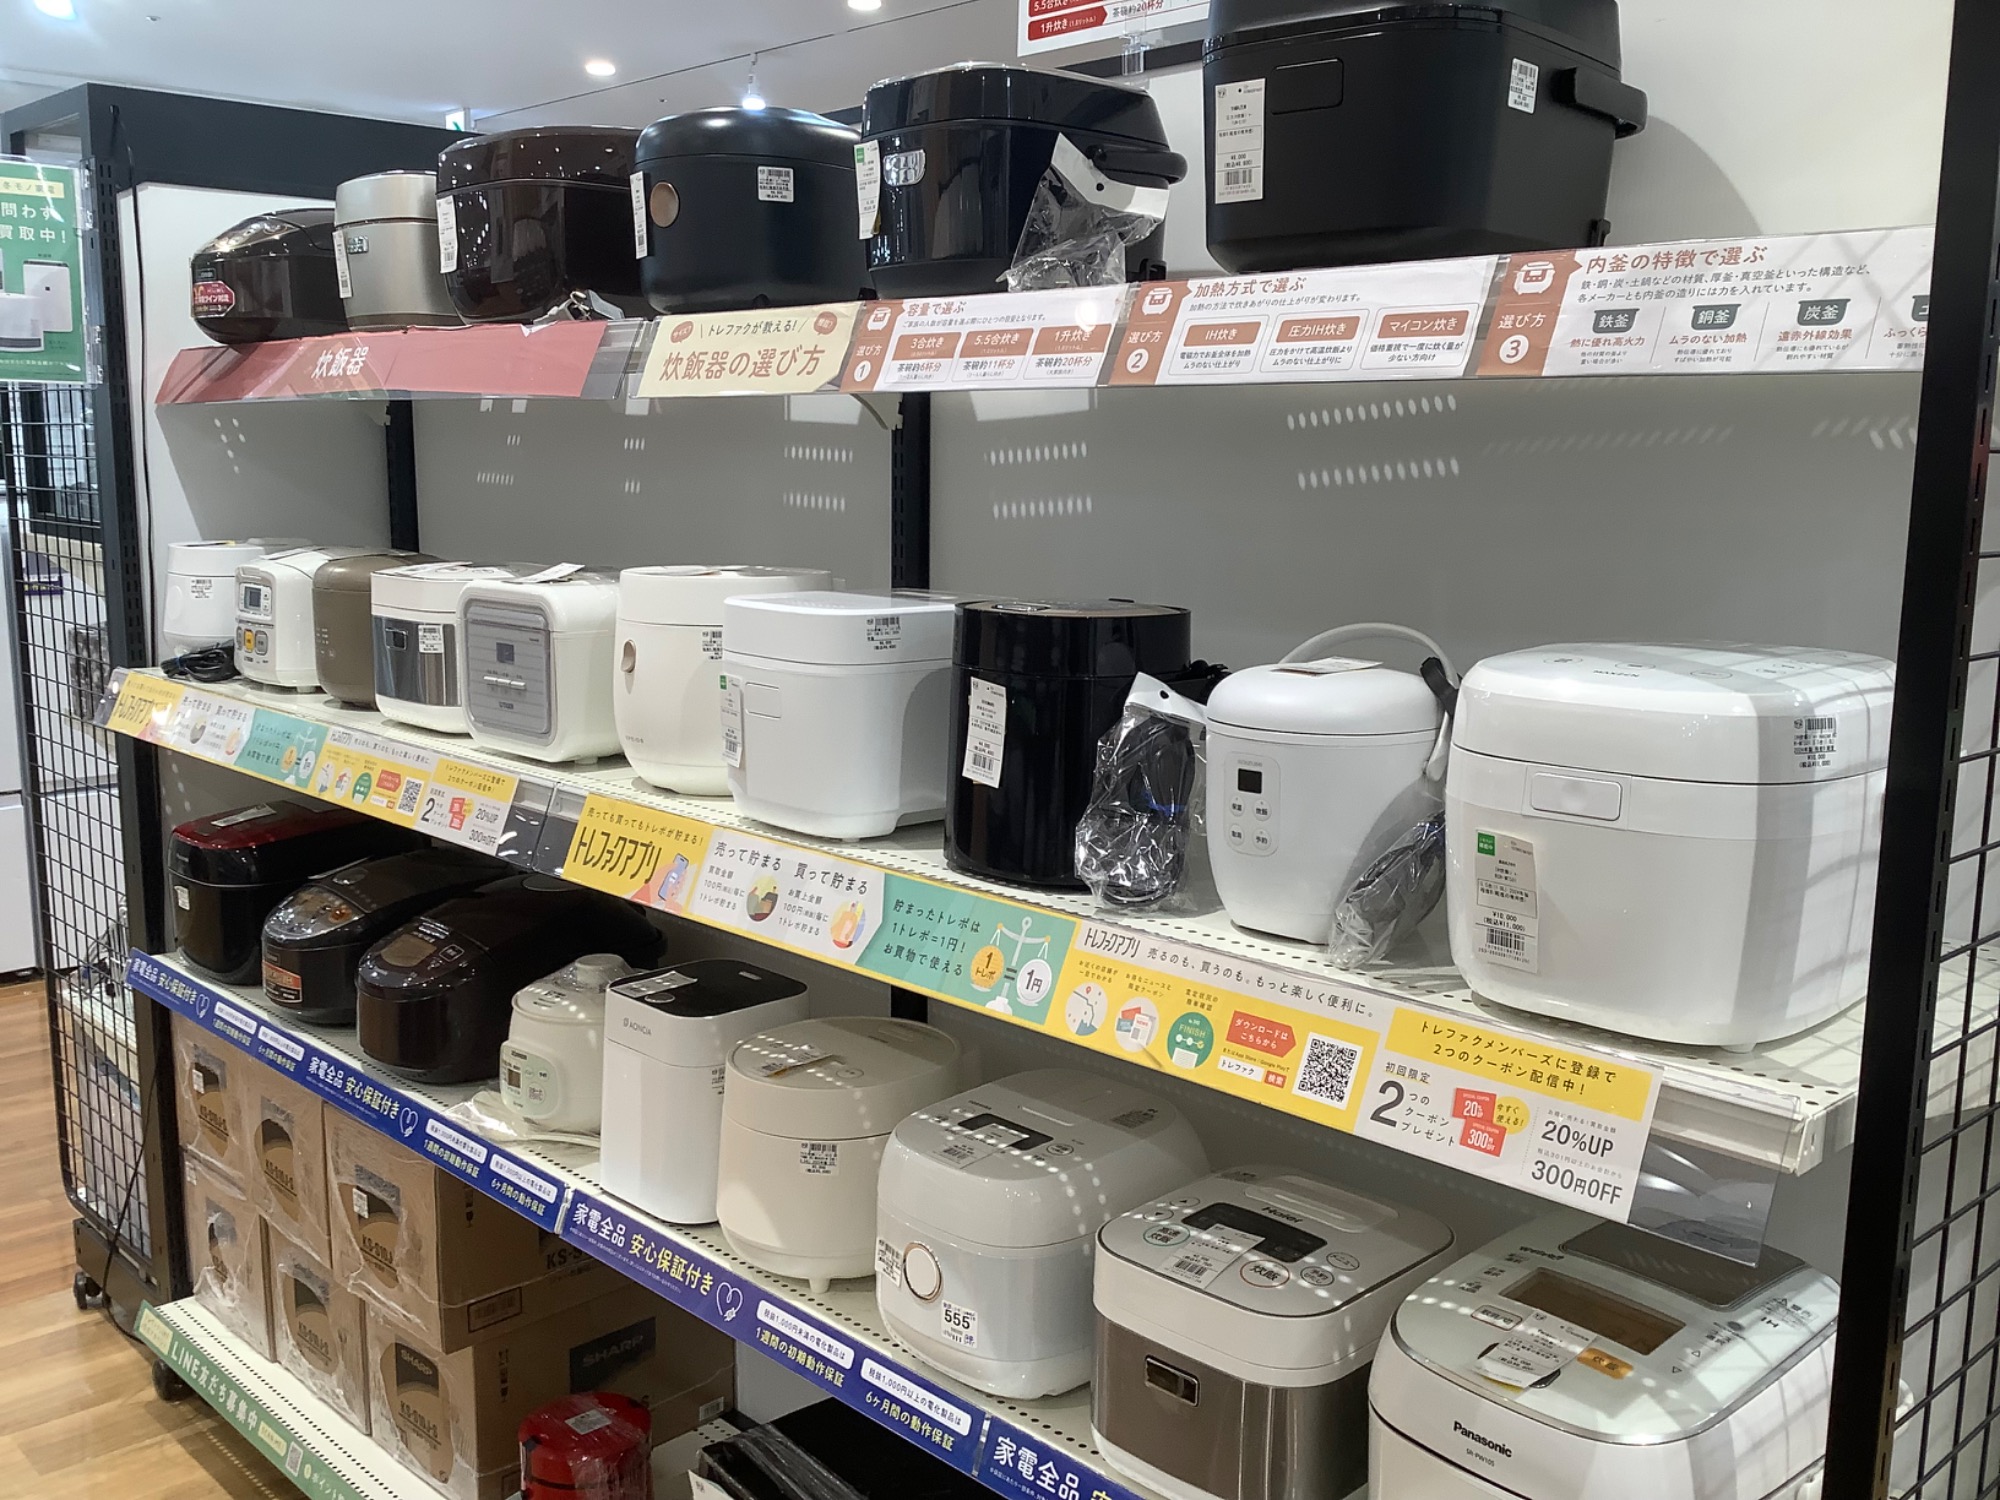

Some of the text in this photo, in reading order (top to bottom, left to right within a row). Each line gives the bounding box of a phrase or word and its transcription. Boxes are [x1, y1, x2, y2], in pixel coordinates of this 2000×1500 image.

[1040, 18, 1068, 33] 1升炊き
[1585, 246, 1768, 274] 内釜の特徴で選ぶ
[1194, 277, 1307, 298] 加熱方式で選ぶ
[1578, 282, 1812, 303] 各メーカーとも内釜の造りには力を入れています。
[907, 301, 967, 317] 容量で選ぶ
[1189, 294, 1361, 312] 加熱の方法で炊きあがりの仕上がりが変わります。
[1803, 304, 1839, 321] 炭釜
[1389, 317, 1459, 332] マイコン炊き
[1498, 312, 1546, 329] 選び方
[1599, 313, 1630, 328] 鉄釜
[1697, 309, 1730, 325] 銅釜
[974, 333, 1020, 346] 5.5合炊き
[1127, 330, 1163, 344] 選び方
[1205, 328, 1238, 341] IH炊き
[1288, 322, 1347, 338] 圧力IH炊き
[1669, 332, 1747, 345] ムラのない加熱
[1777, 329, 1853, 342] 遠赤外線効果
[856, 344, 883, 356] 選び方
[910, 336, 944, 349] 3合炊き
[310, 345, 370, 379] 炊飯器
[659, 345, 825, 382] 炊飯器の選び方
[420, 797, 435, 823] 2
[587, 807, 704, 846] 売っても買ってもトレポが貯まる！
[573, 826, 663, 884] トレファクアプリ
[714, 841, 868, 895] 売って貯まる 買って貯まる
[779, 917, 820, 936] 1トレポ貯まる
[892, 898, 981, 934] 貯まったトレポは
[1493, 911, 1517, 922] ¥10,000
[132, 957, 159, 984] 家電全品
[883, 943, 963, 977] お買物で使える
[984, 952, 994, 968] 1
[975, 967, 996, 981] トレポ
[1025, 969, 1043, 993] 1円
[1084, 927, 1374, 1018] トレファクアプリ 売るのも、買うのも。もっと楽しく便利に。
[1179, 1023, 1206, 1038] FINISH
[1234, 1017, 1289, 1041] ダウンロードは
[1240, 1030, 1278, 1050] こちらから
[1421, 1021, 1617, 1084] トレファクメンバーズに登録で
[1220, 1058, 1255, 1076] トレファク
[1385, 1061, 1431, 1084] 初回限定
[1433, 1043, 1586, 1095] 2つのクーポン配信中！
[308, 1056, 400, 1120] 家電全品 安心保証付き
[1267, 1073, 1284, 1086] 検索
[1369, 1080, 1404, 1128] 2
[1408, 1092, 1430, 1106] つの
[1497, 1103, 1519, 1114] 今すぐ
[1404, 1106, 1450, 1127] クーポン
[1496, 1114, 1525, 1127] 使える！
[1401, 1120, 1454, 1147] プレゼント
[1541, 1120, 1614, 1158] 20%UP
[1531, 1159, 1623, 1204] 300円OFF
[1261, 1206, 1303, 1223] Haier
[572, 1202, 714, 1296] 家電全品 安心保証付き
[1250, 1265, 1281, 1282] 炊飯
[944, 1308, 970, 1330] 555
[582, 1335, 644, 1368] SHARP
[755, 1326, 845, 1388] 1週間の初期動作保証
[170, 1341, 258, 1431] LINE友だち募集中
[868, 1366, 963, 1428] 税抜1,000円以上の電化製品は
[1453, 1420, 1512, 1458] Panasonic
[993, 1435, 1080, 1500] 家電全品
